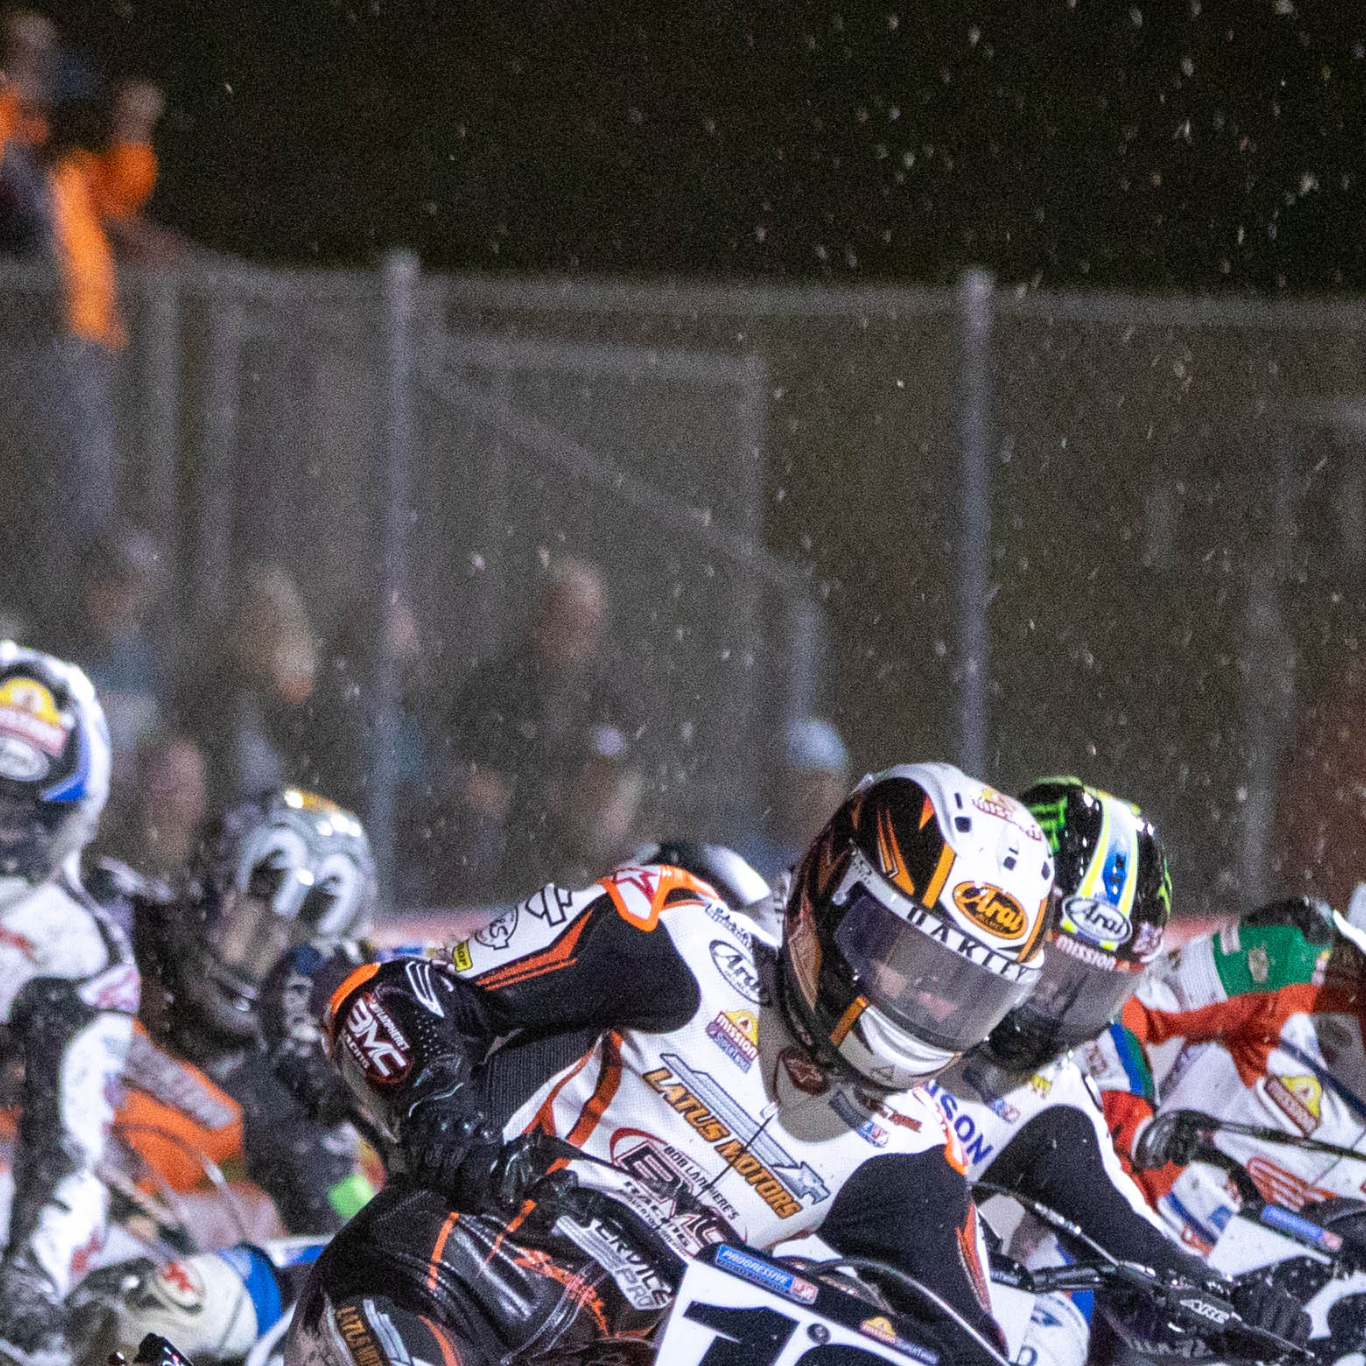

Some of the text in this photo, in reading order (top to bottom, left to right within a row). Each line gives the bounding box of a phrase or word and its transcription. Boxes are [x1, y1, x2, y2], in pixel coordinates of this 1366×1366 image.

[960, 886, 1024, 930] Arai
[1069, 900, 1128, 936] Arai
[341, 1029, 371, 1069] ACING
[641, 1066, 732, 1142] LATUS
[663, 1145, 740, 1221] BOB LANERE'S
[713, 1138, 804, 1220] MOTORS
[593, 1220, 674, 1307] ERVICE
[721, 1249, 791, 1286] PROGRESSIVE
[613, 1266, 657, 1308] PRO
